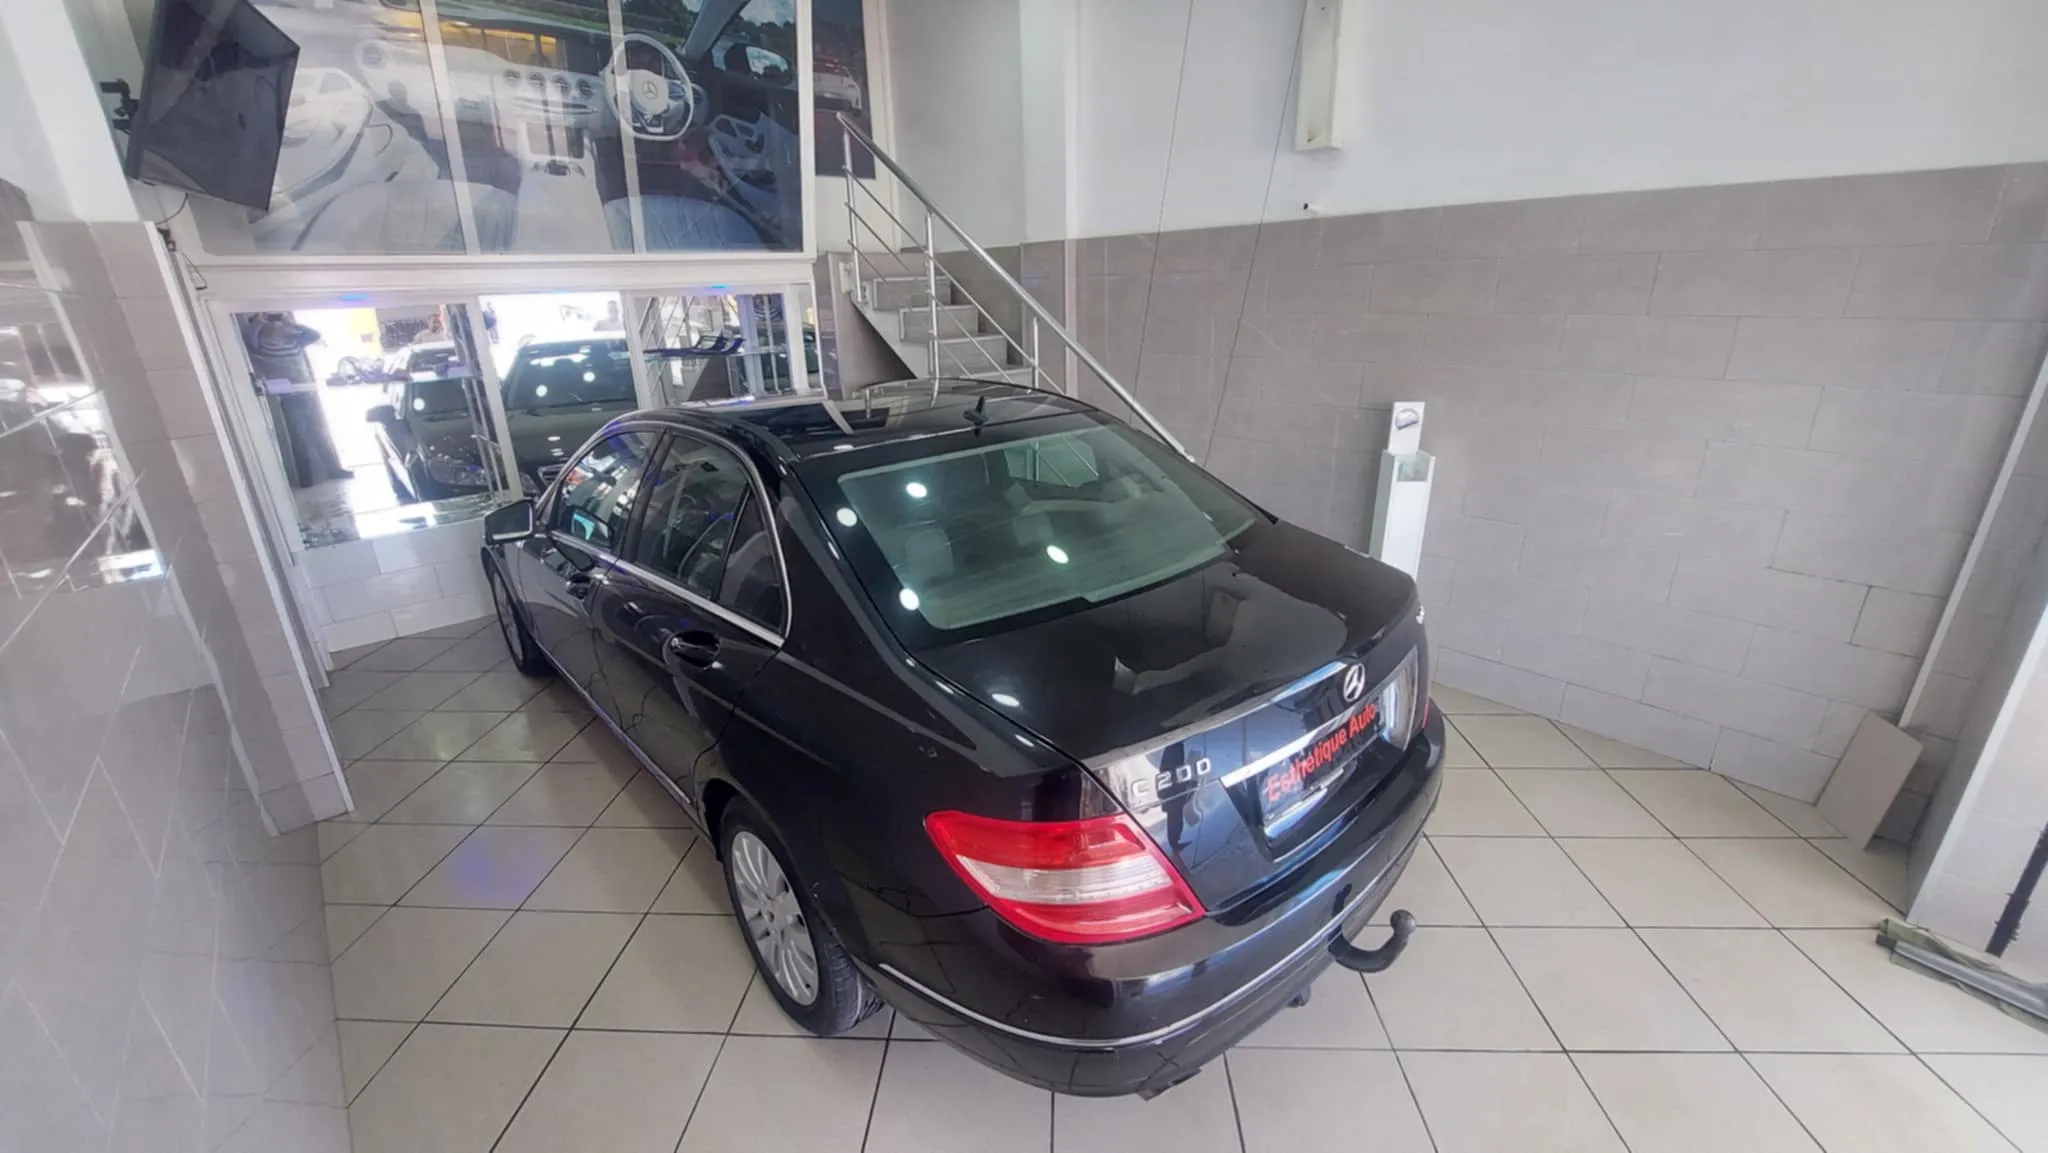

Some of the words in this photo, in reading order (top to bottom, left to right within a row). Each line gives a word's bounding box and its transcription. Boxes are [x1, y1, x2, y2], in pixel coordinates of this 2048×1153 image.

[1349, 703, 1377, 739] Auto
[1131, 779, 1151, 798] C
[1156, 757, 1212, 792] 200
